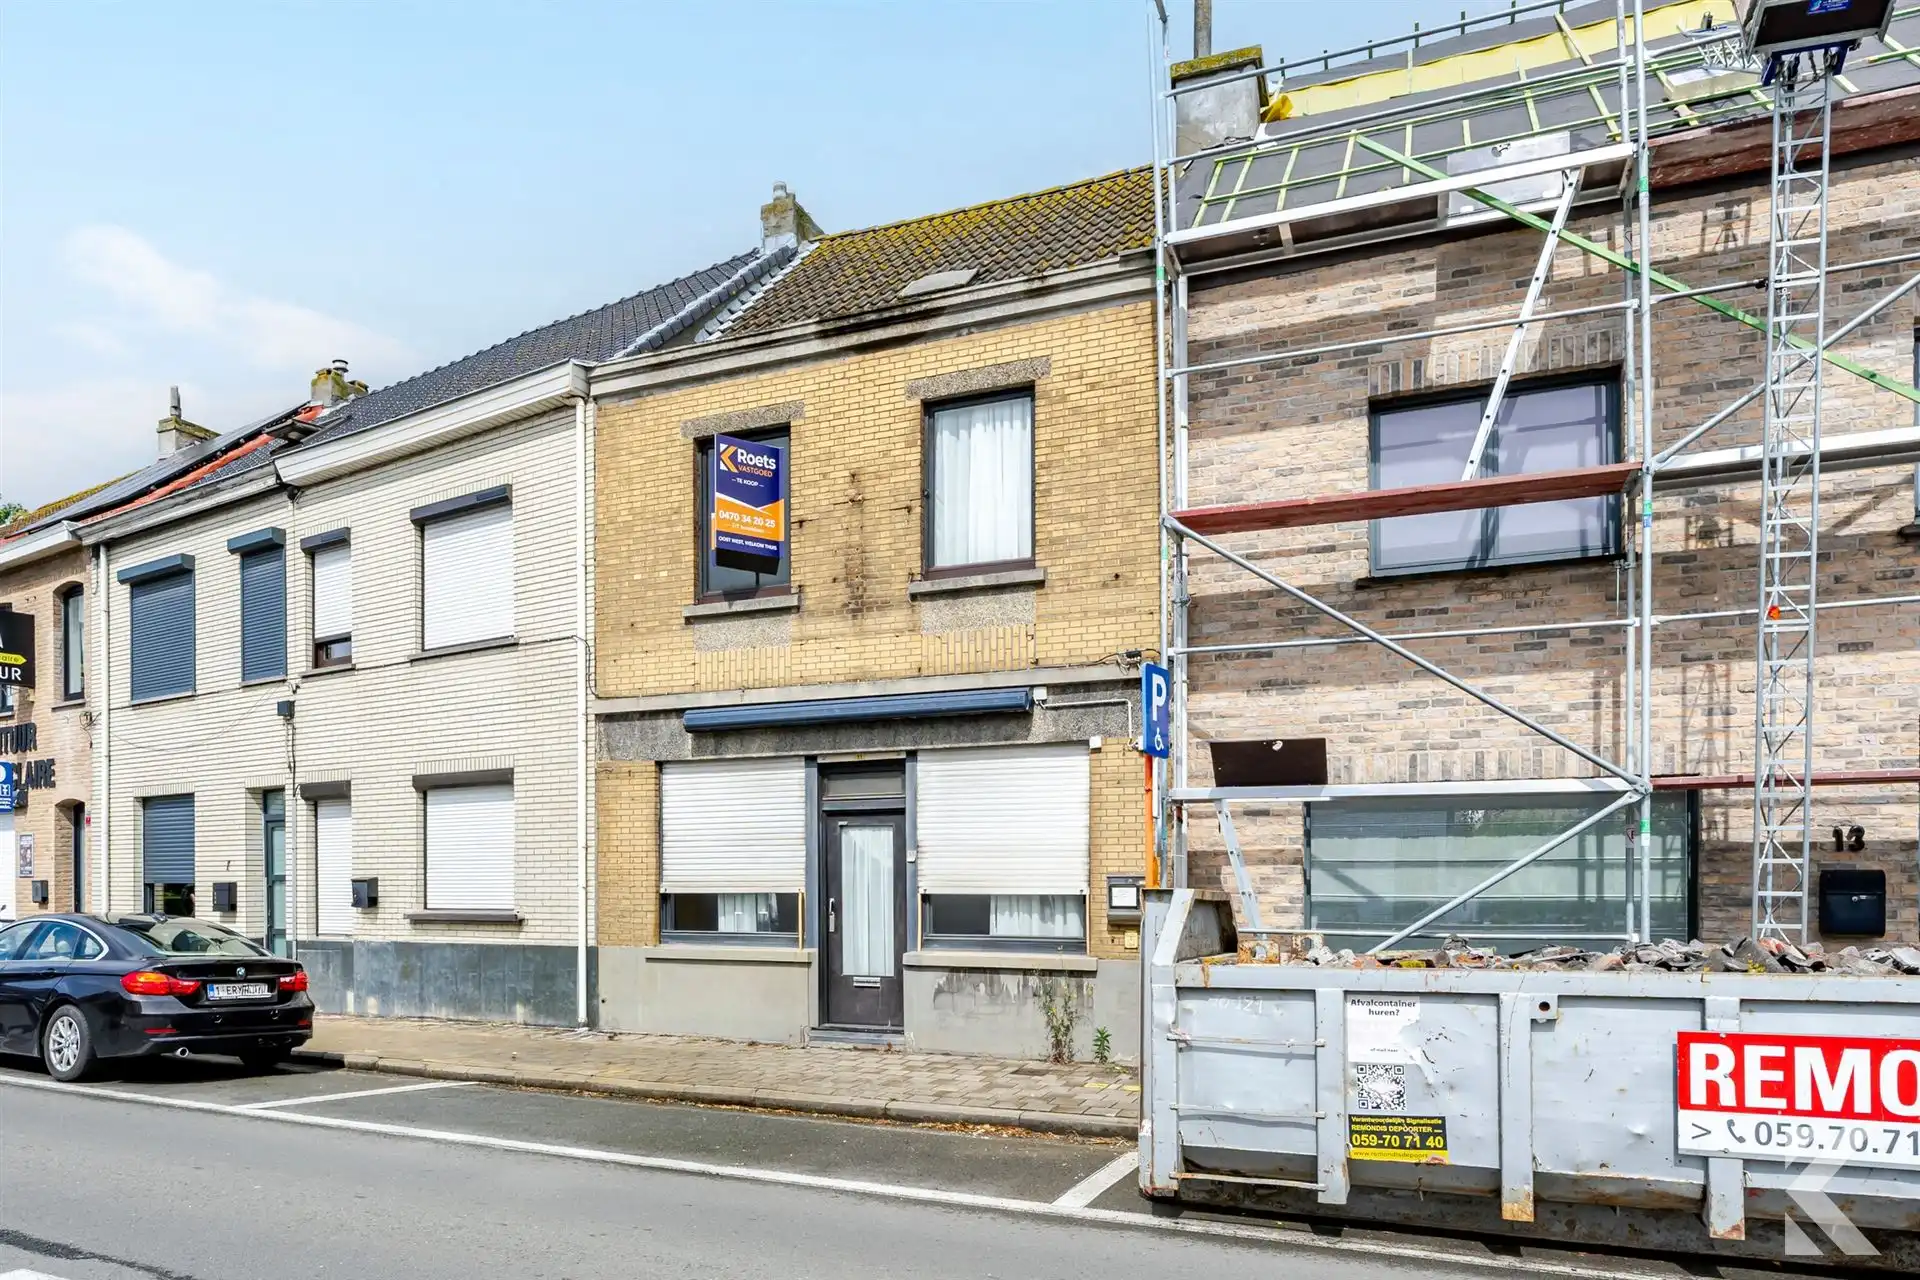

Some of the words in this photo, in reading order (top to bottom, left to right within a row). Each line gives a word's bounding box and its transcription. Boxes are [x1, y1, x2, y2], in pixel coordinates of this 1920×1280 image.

[737, 448, 776, 470] Roets
[737, 464, 773, 478] VASTGOED
[718, 510, 740, 521] 0470
[741, 514, 752, 523] 34
[753, 516, 764, 526] 20
[765, 518, 776, 528] 25
[1152, 673, 1167, 721] P
[0, 722, 37, 755] TUUR
[1832, 825, 1866, 852] 13
[1350, 998, 1417, 1008] Afvalcontainer
[1368, 1008, 1401, 1016] huren?
[1689, 1042, 1920, 1117] REMO
[1351, 1124, 1388, 1132] REMONDIS
[1388, 1125, 1433, 1133] DEPOORTER
[1754, 1121, 1920, 1156] 059.70.71
[1351, 1133, 1400, 1148] 059-70
[1403, 1135, 1421, 1148] 71
[1425, 1136, 1444, 1149] 40
